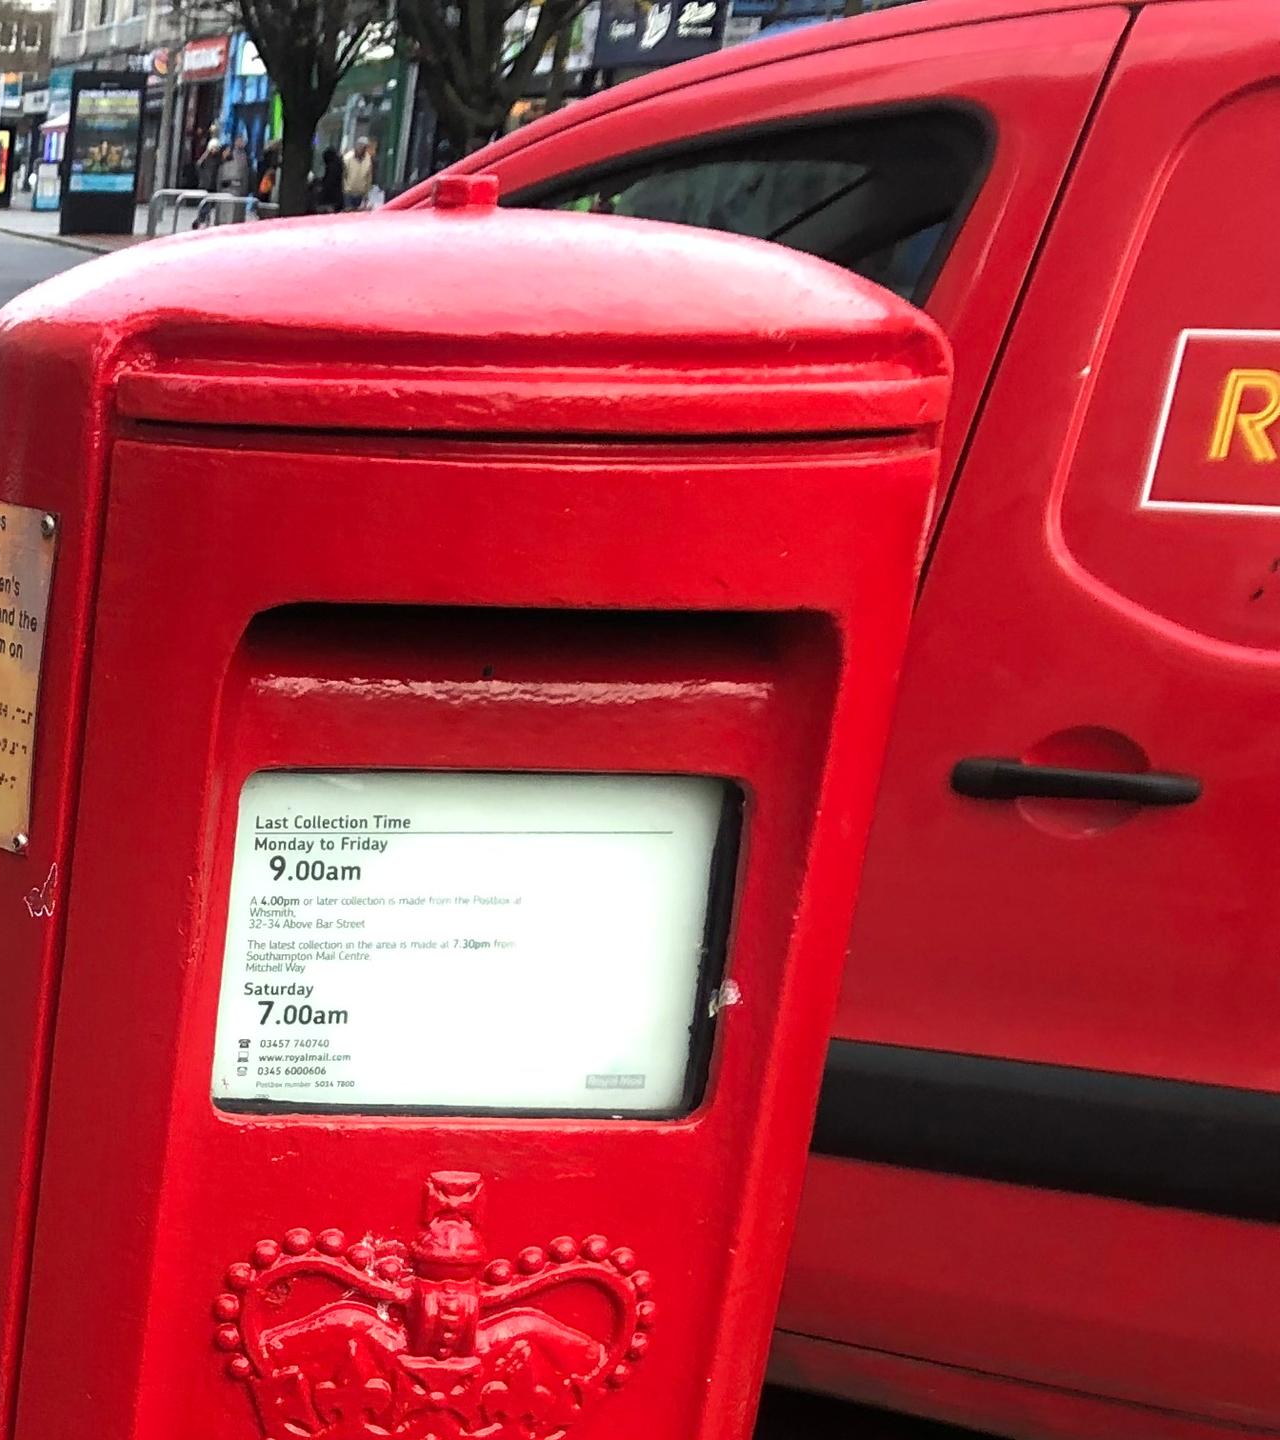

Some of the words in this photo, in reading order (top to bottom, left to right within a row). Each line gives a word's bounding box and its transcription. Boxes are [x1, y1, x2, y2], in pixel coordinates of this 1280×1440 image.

[19, 609, 38, 632] the
[9, 641, 24, 660] on
[255, 815, 289, 830] Last
[294, 815, 369, 830] Collection
[373, 815, 412, 829] Time
[254, 837, 315, 854] Monday
[320, 838, 335, 851] to
[341, 836, 389, 854] Friday
[269, 855, 362, 882] 9.00am
[249, 896, 258, 906] A
[260, 896, 300, 907] 4.00pm
[302, 898, 313, 906] or
[316, 896, 339, 906] later
[340, 896, 386, 906] collection
[388, 896, 396, 906] is
[398, 896, 426, 906] made
[428, 896, 452, 906] from
[454, 896, 471, 906] the
[473, 895, 510, 906] Postbox
[249, 907, 296, 919] Whsmith,
[248, 918, 281, 929] 32-34
[282, 918, 313, 929] Above
[315, 918, 334, 929] Bar
[335, 918, 366, 929] Street
[247, 939, 267, 950] The
[269, 940, 296, 950] latest
[298, 940, 343, 950] collection
[345, 941, 355, 950] in
[357, 940, 373, 950] the
[375, 941, 397, 950] area
[399, 940, 408, 950] is
[410, 939, 438, 950] made
[439, 940, 449, 950] at
[453, 939, 491, 950] 7.30pm
[246, 951, 313, 963] Southampton
[315, 951, 336, 961] Mail
[245, 962, 283, 973] Mitchell
[285, 962, 306, 974] Way
[243, 982, 314, 999] Saturday
[257, 1000, 349, 1026] 7.00am
[259, 1039, 290, 1049] 03457
[293, 1039, 330, 1049] 740740
[258, 1053, 352, 1065] www.royalmail.com
[257, 1067, 282, 1076] 0345
[284, 1067, 327, 1076] 6000606
